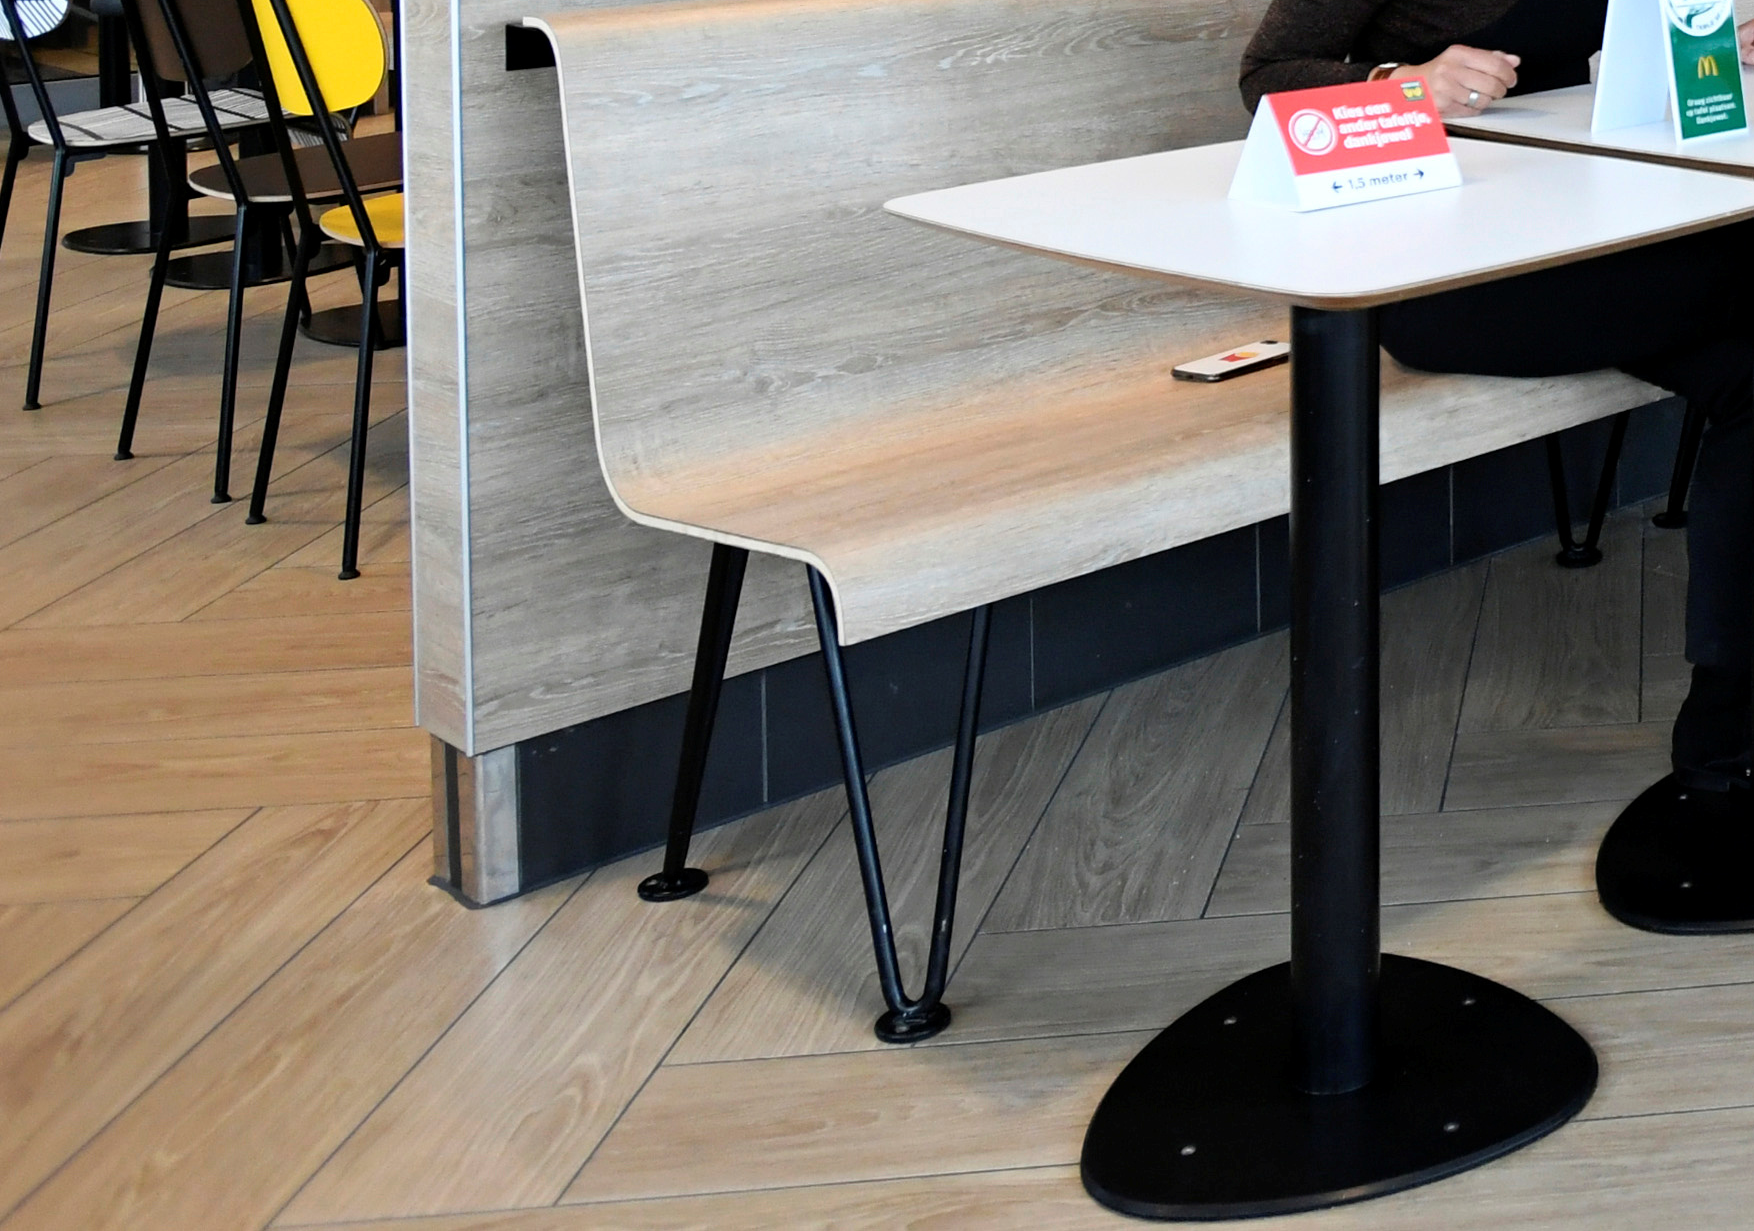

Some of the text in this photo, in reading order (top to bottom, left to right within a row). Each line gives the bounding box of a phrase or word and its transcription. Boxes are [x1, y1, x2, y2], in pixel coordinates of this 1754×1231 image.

[1332, 102, 1391, 120] Kies een
[1339, 118, 1378, 135] ander
[1379, 111, 1432, 129] tafeltje,
[1369, 172, 1408, 188] meter
